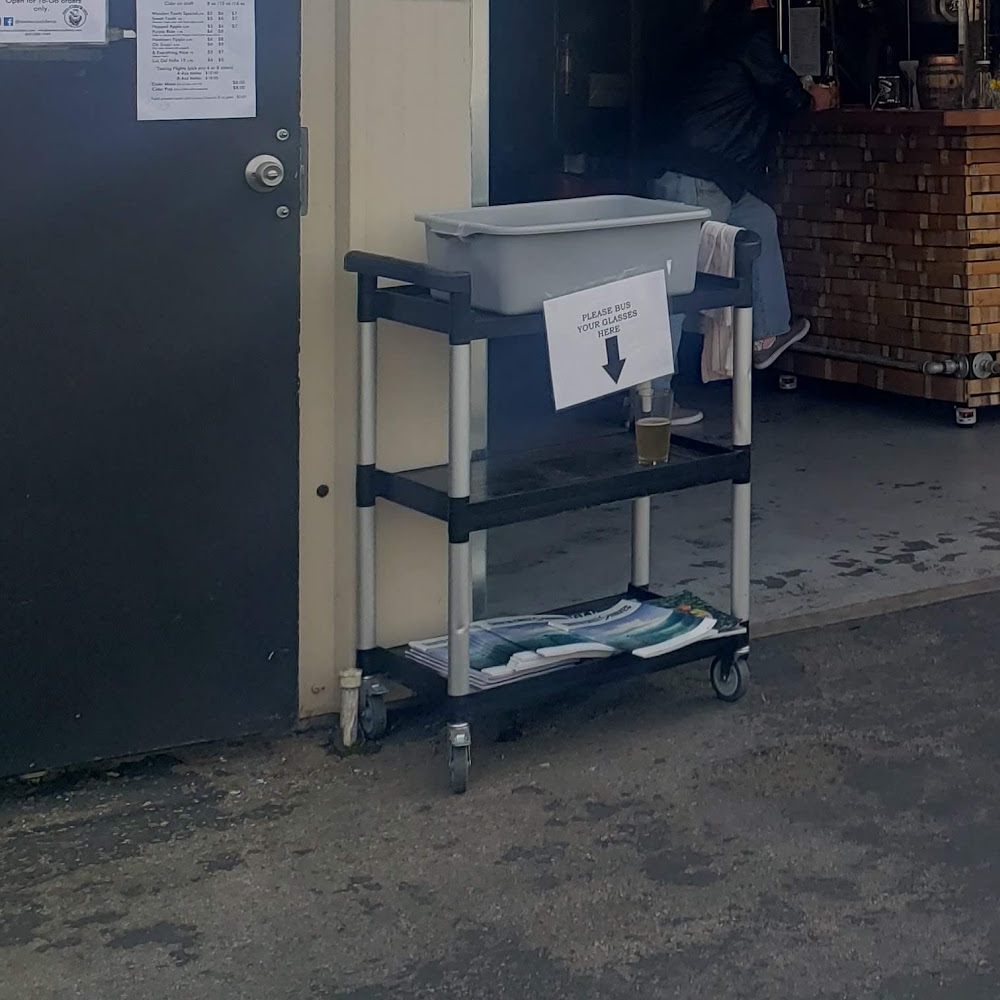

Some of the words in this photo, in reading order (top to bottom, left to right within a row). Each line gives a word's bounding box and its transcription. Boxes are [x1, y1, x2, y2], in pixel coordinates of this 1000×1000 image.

[582, 307, 612, 321] PLEASE
[615, 302, 631, 312] BUS
[577, 320, 600, 333] YOUR
[602, 310, 638, 326] GLASSES
[598, 325, 620, 338] HERE
